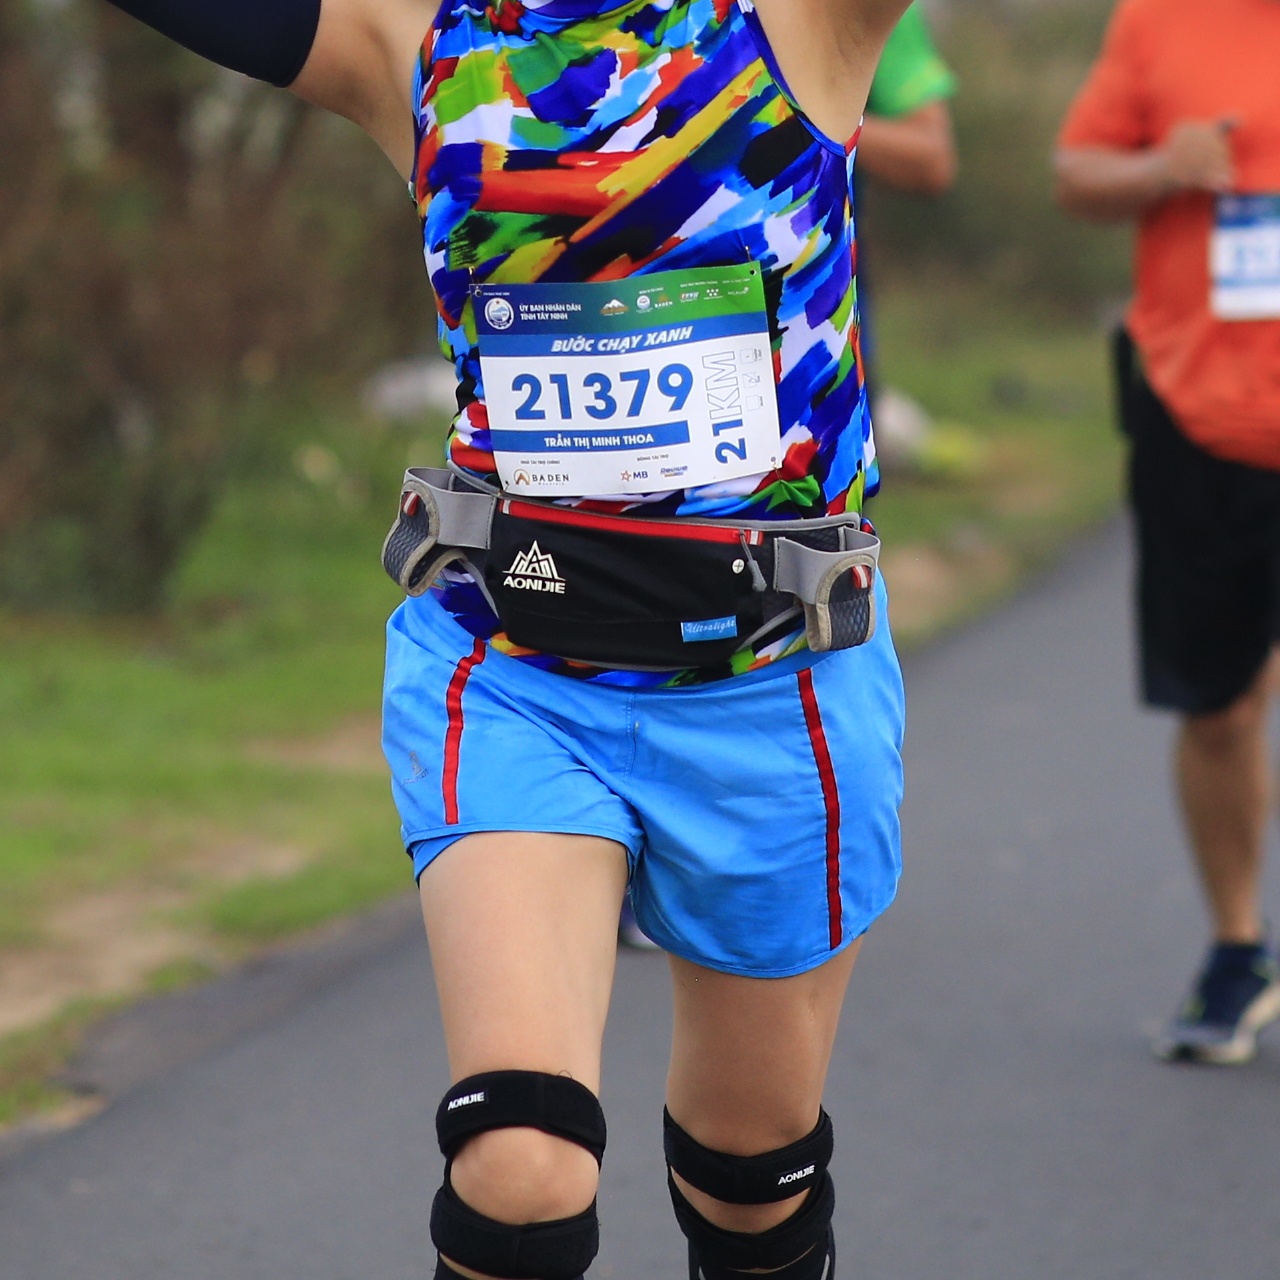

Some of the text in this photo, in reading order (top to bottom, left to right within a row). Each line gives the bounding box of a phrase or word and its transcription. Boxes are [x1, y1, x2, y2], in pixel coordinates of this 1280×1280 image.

[537, 312, 549, 320] TÂY
[545, 303, 565, 311] NHÂN
[551, 326, 694, 354] BƯỚC CHẠY XANH
[511, 363, 694, 420] 21379
[702, 350, 748, 464] 21KM
[544, 433, 654, 450] TRẦN THỊ MINH THOA
[532, 473, 569, 482] BADEN
[633, 471, 648, 480] MB
[503, 575, 566, 594] AONIJIE
[685, 618, 735, 634] Ultralight
[447, 1091, 485, 1111] AONIJIE
[778, 1164, 815, 1186] AONIJIE
